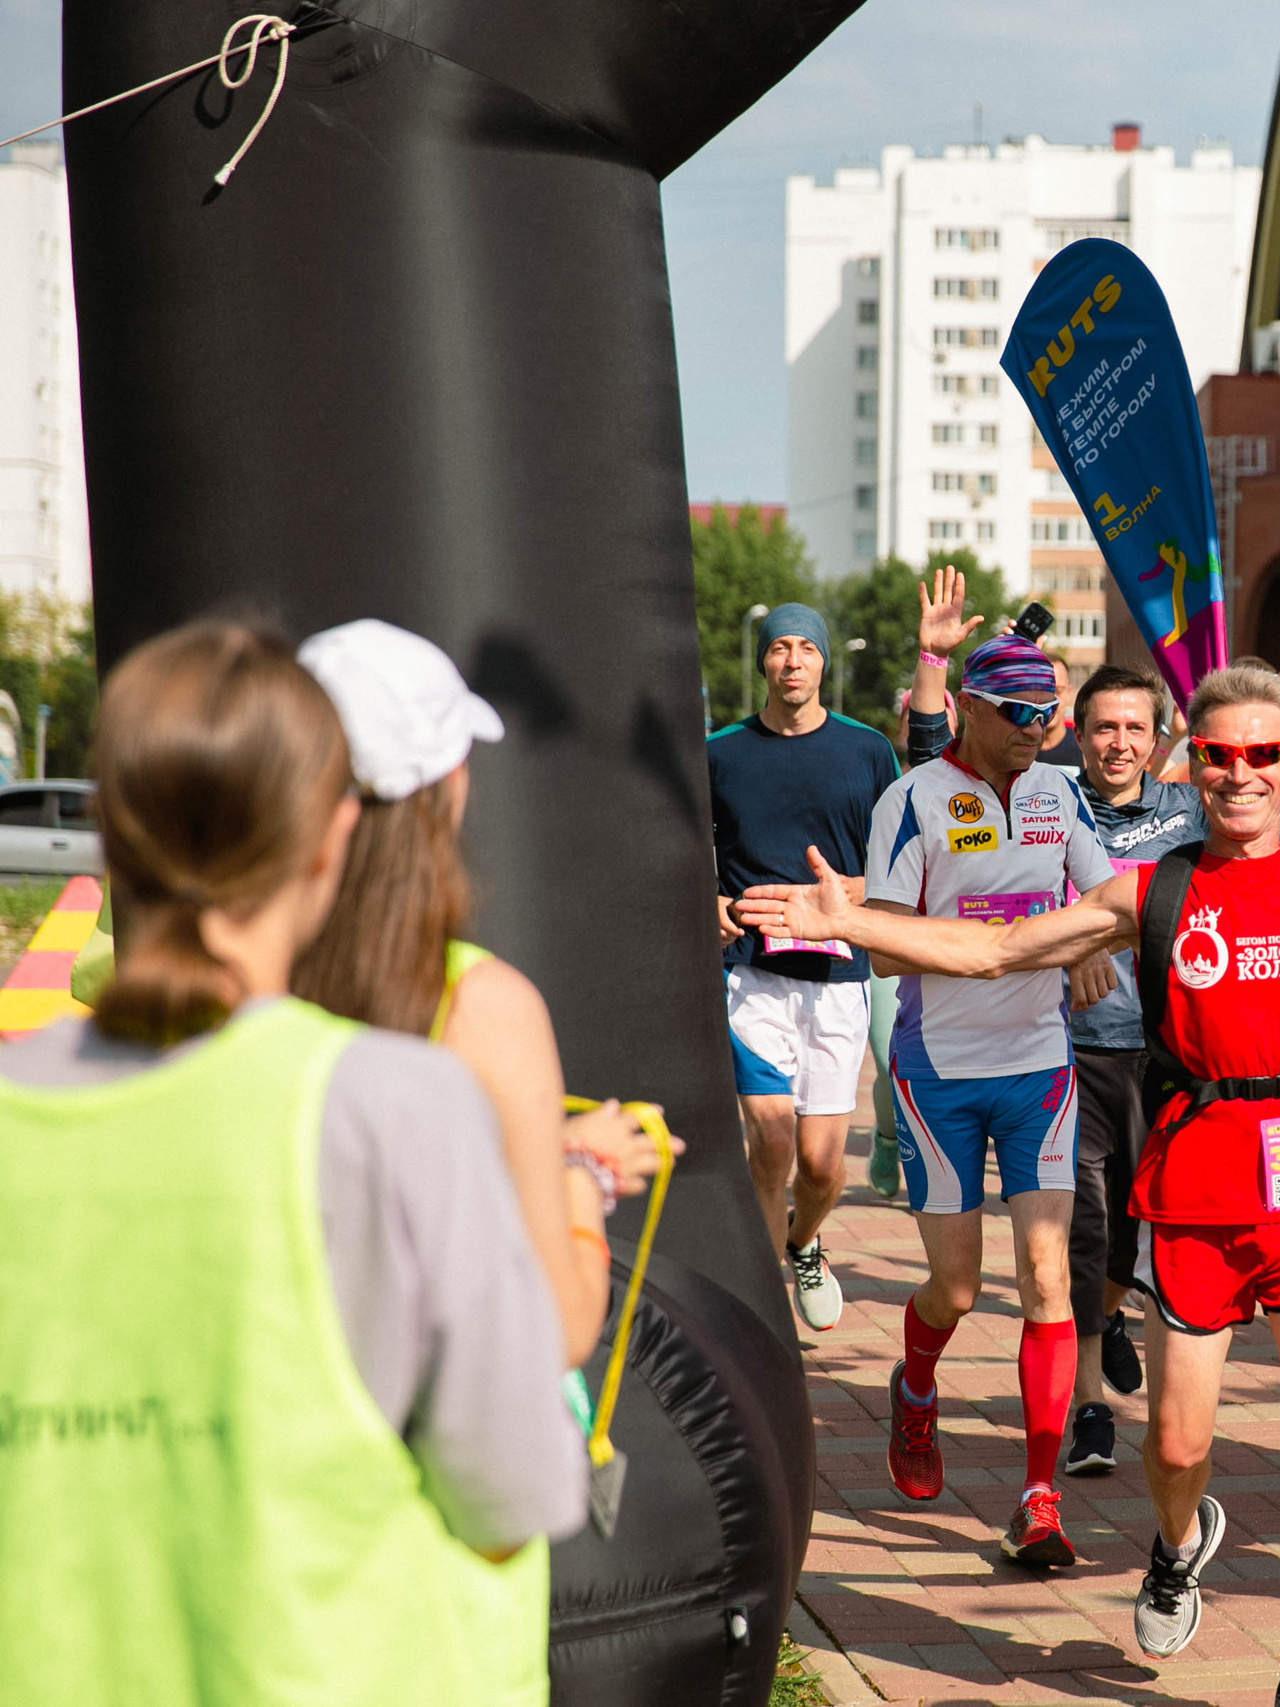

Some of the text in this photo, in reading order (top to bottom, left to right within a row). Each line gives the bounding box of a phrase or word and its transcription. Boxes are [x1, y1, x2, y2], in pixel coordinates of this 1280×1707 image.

[1027, 274, 1122, 398] RUTS
[1072, 338, 1147, 432] БЫСТРОМ
[1073, 374, 1156, 476] ПО ГОРОДУ
[1093, 492, 1126, 527] 1
[1104, 486, 1162, 542] ВОЛНА
[1021, 816, 1060, 824] SATURN
[1236, 937, 1266, 946] БЕГОМ
